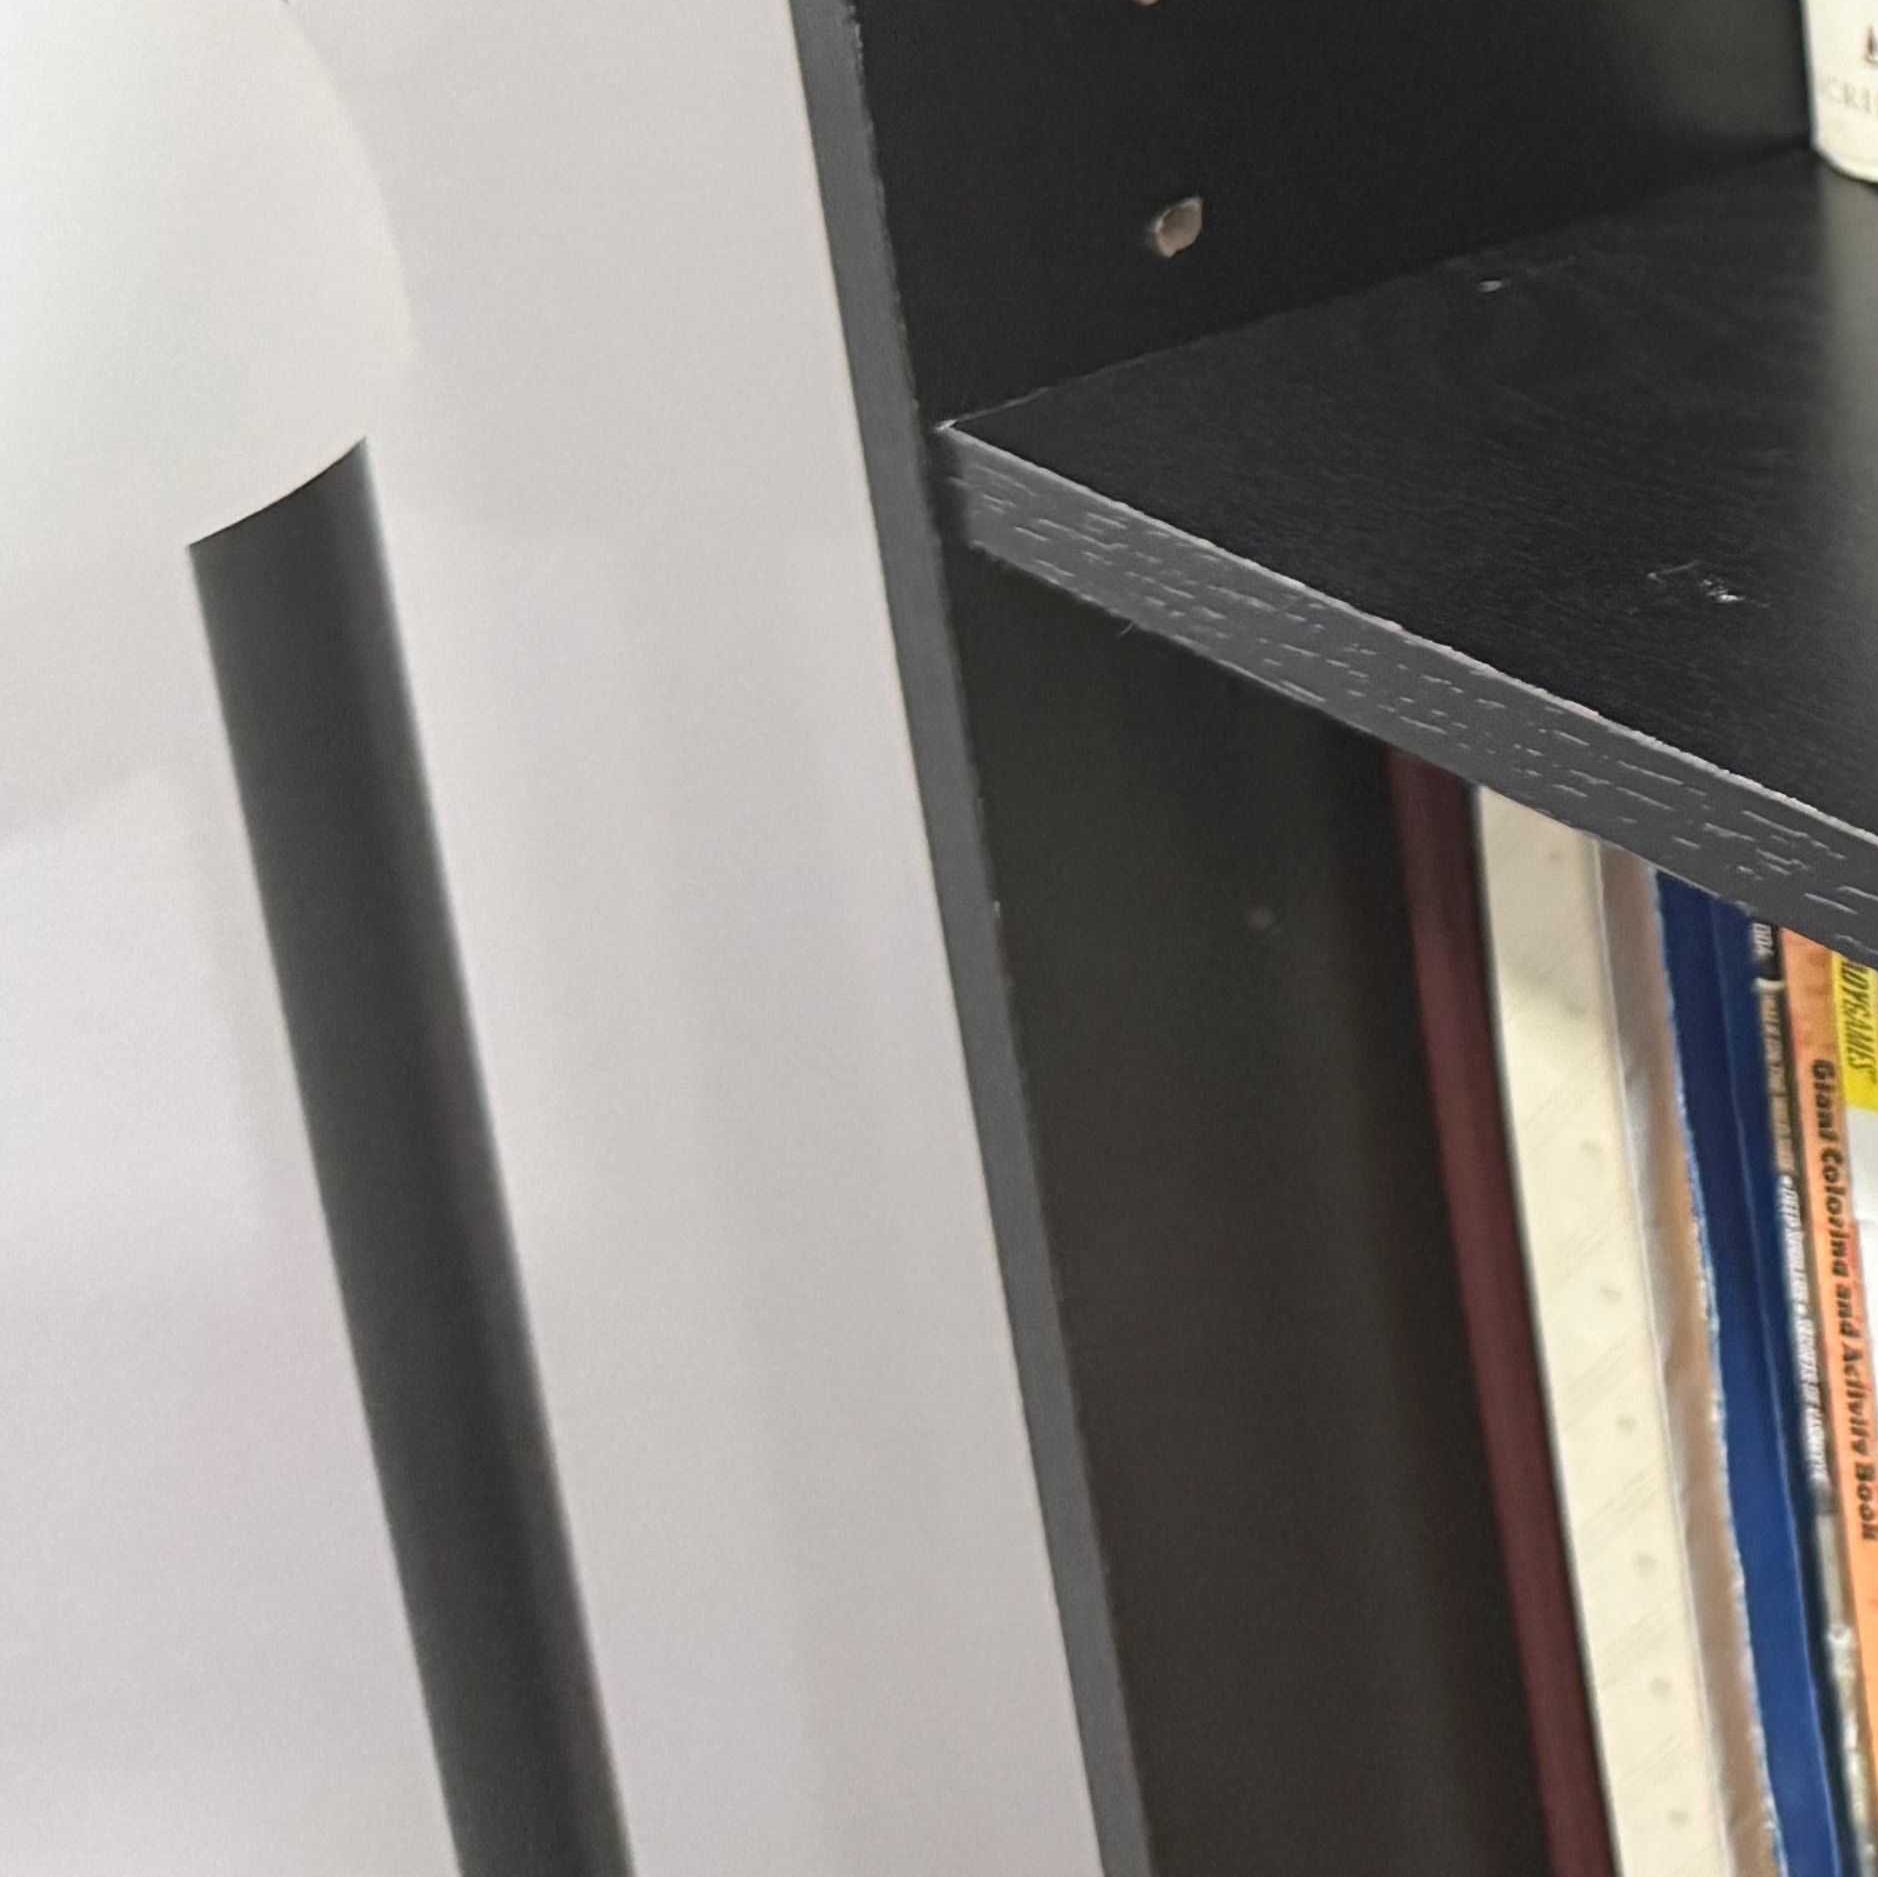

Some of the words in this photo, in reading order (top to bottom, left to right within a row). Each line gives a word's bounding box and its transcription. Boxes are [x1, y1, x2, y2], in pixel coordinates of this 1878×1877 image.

[1813, 1058, 1838, 1142] Giant
[1821, 1148, 1849, 1278] Coloring
[1834, 1282, 1861, 1340] and
[1840, 1341, 1872, 1456] Activity
